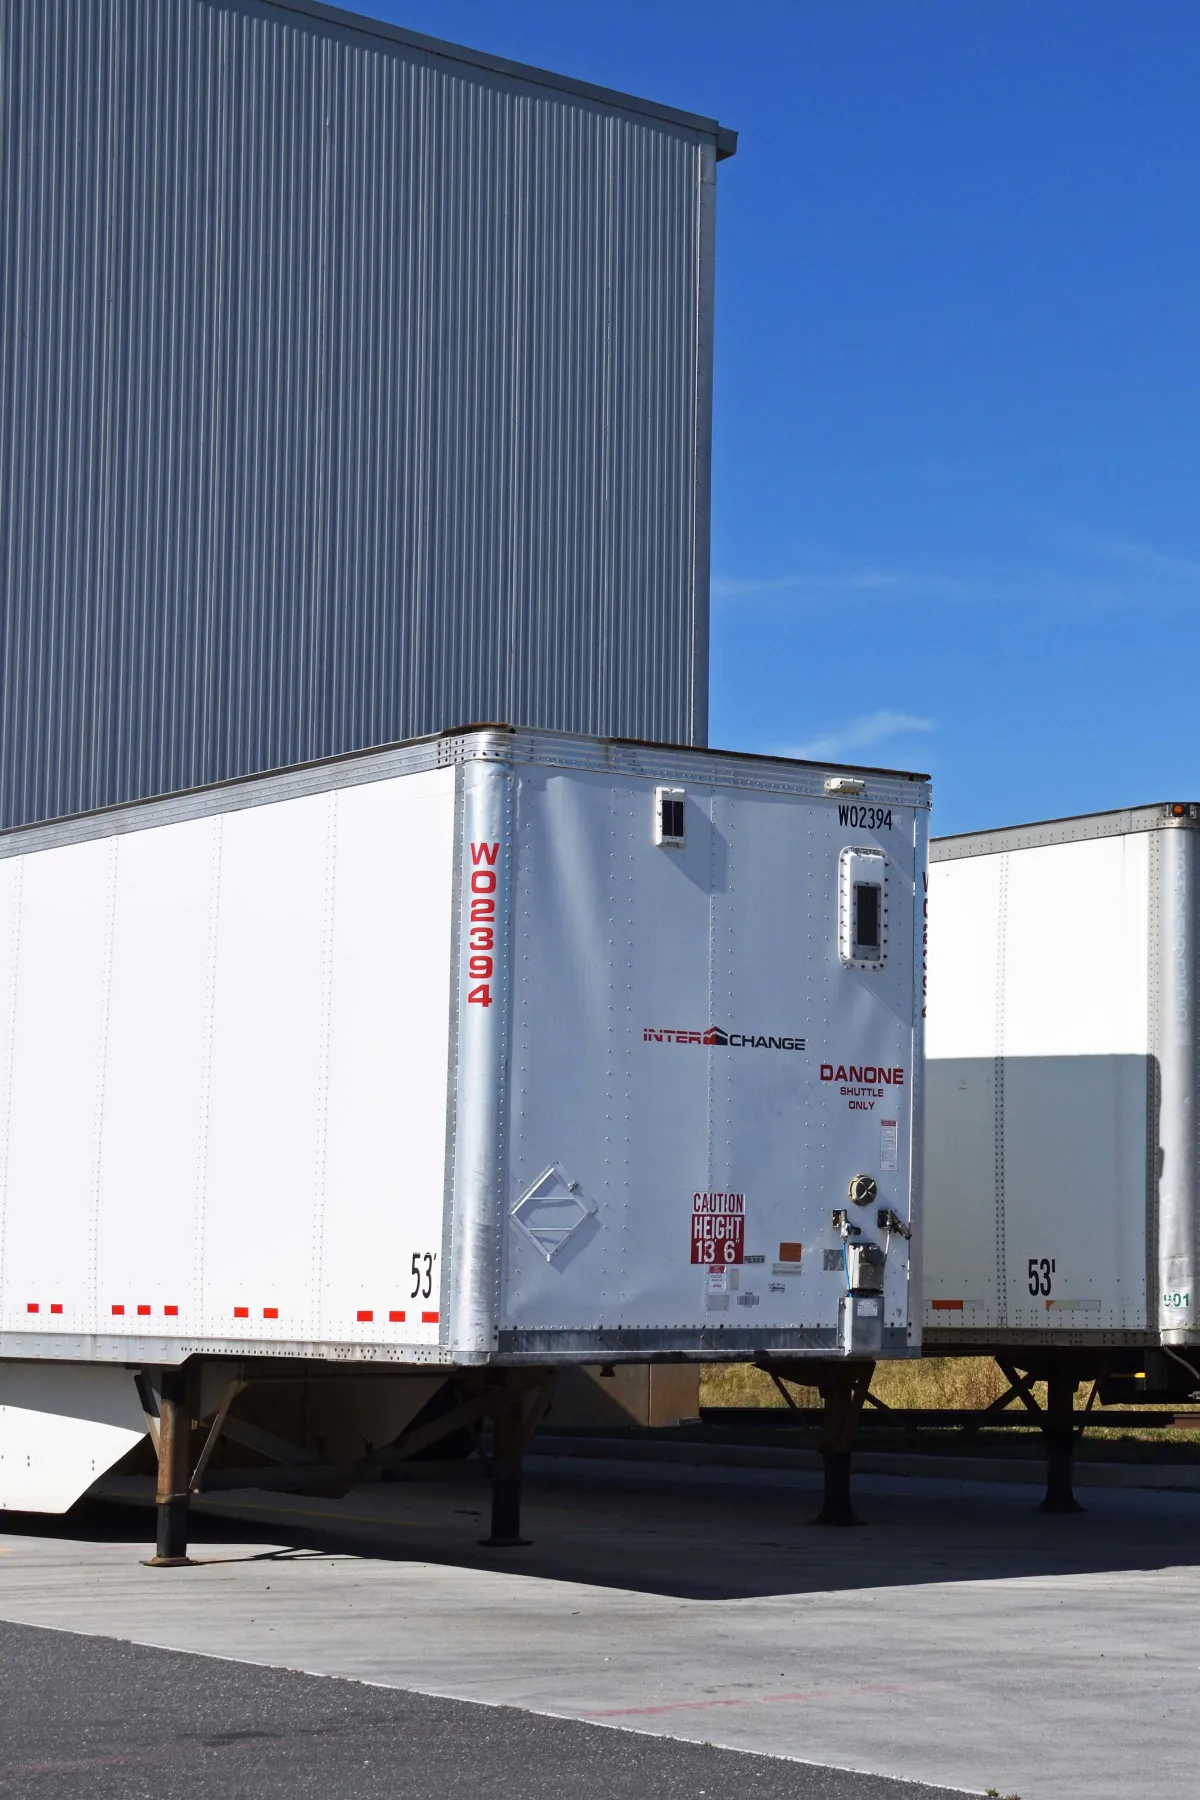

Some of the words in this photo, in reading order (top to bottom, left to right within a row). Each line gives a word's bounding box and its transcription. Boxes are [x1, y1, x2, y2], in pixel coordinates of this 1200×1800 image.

[819, 1064, 904, 1085] DANONE
[840, 1086, 884, 1098] SHUTTLE
[848, 1100, 876, 1111] ONLY
[693, 1192, 744, 1213] CAUTION
[693, 1216, 742, 1239] HEIGHT
[410, 1251, 438, 1299] 53'
[1028, 1258, 1056, 1297] 53'
